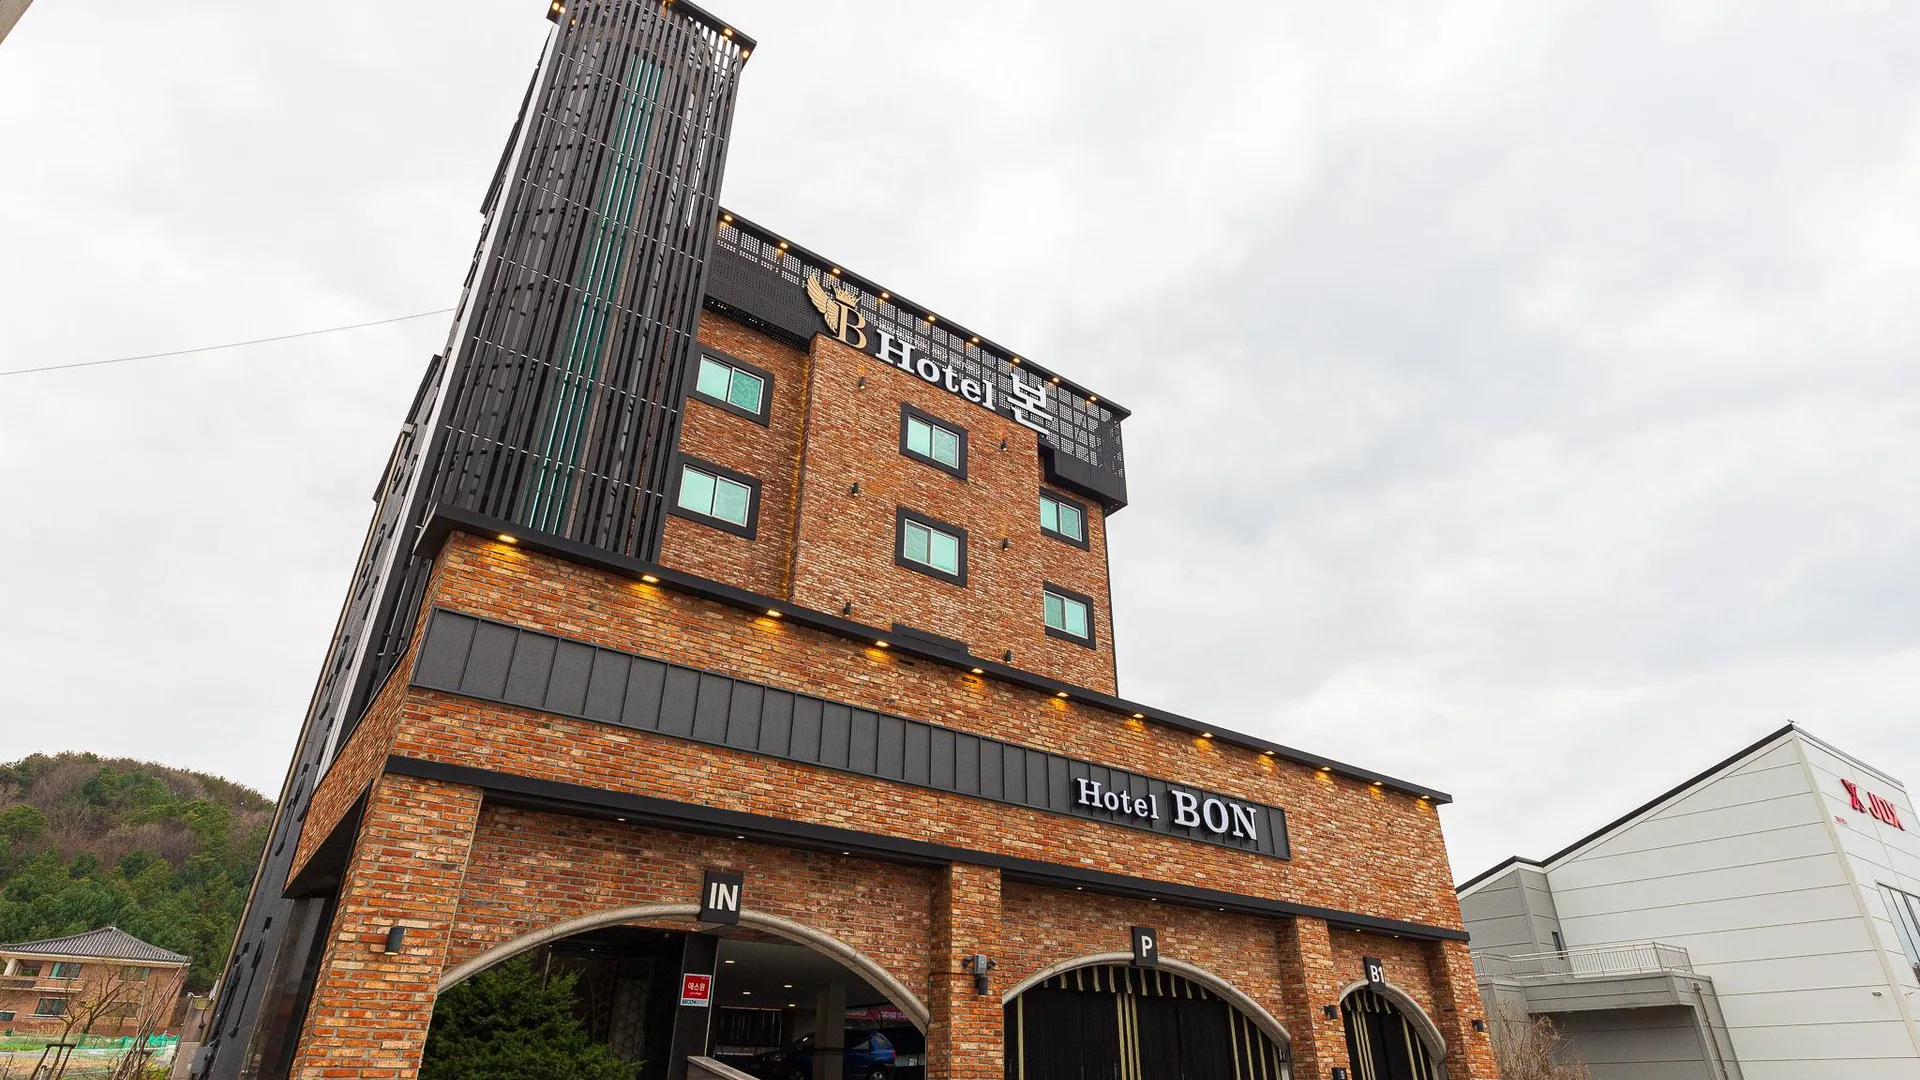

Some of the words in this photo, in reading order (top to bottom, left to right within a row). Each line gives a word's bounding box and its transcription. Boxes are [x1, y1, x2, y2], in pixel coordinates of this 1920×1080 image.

[833, 301, 867, 349] B
[875, 328, 998, 411] Hotel
[1006, 372, 1053, 436] 본
[1076, 778, 1159, 820] Hotel
[1171, 789, 1257, 841] BON
[708, 882, 739, 912] IN
[1141, 935, 1153, 958] P
[1370, 964, 1385, 983] B1
